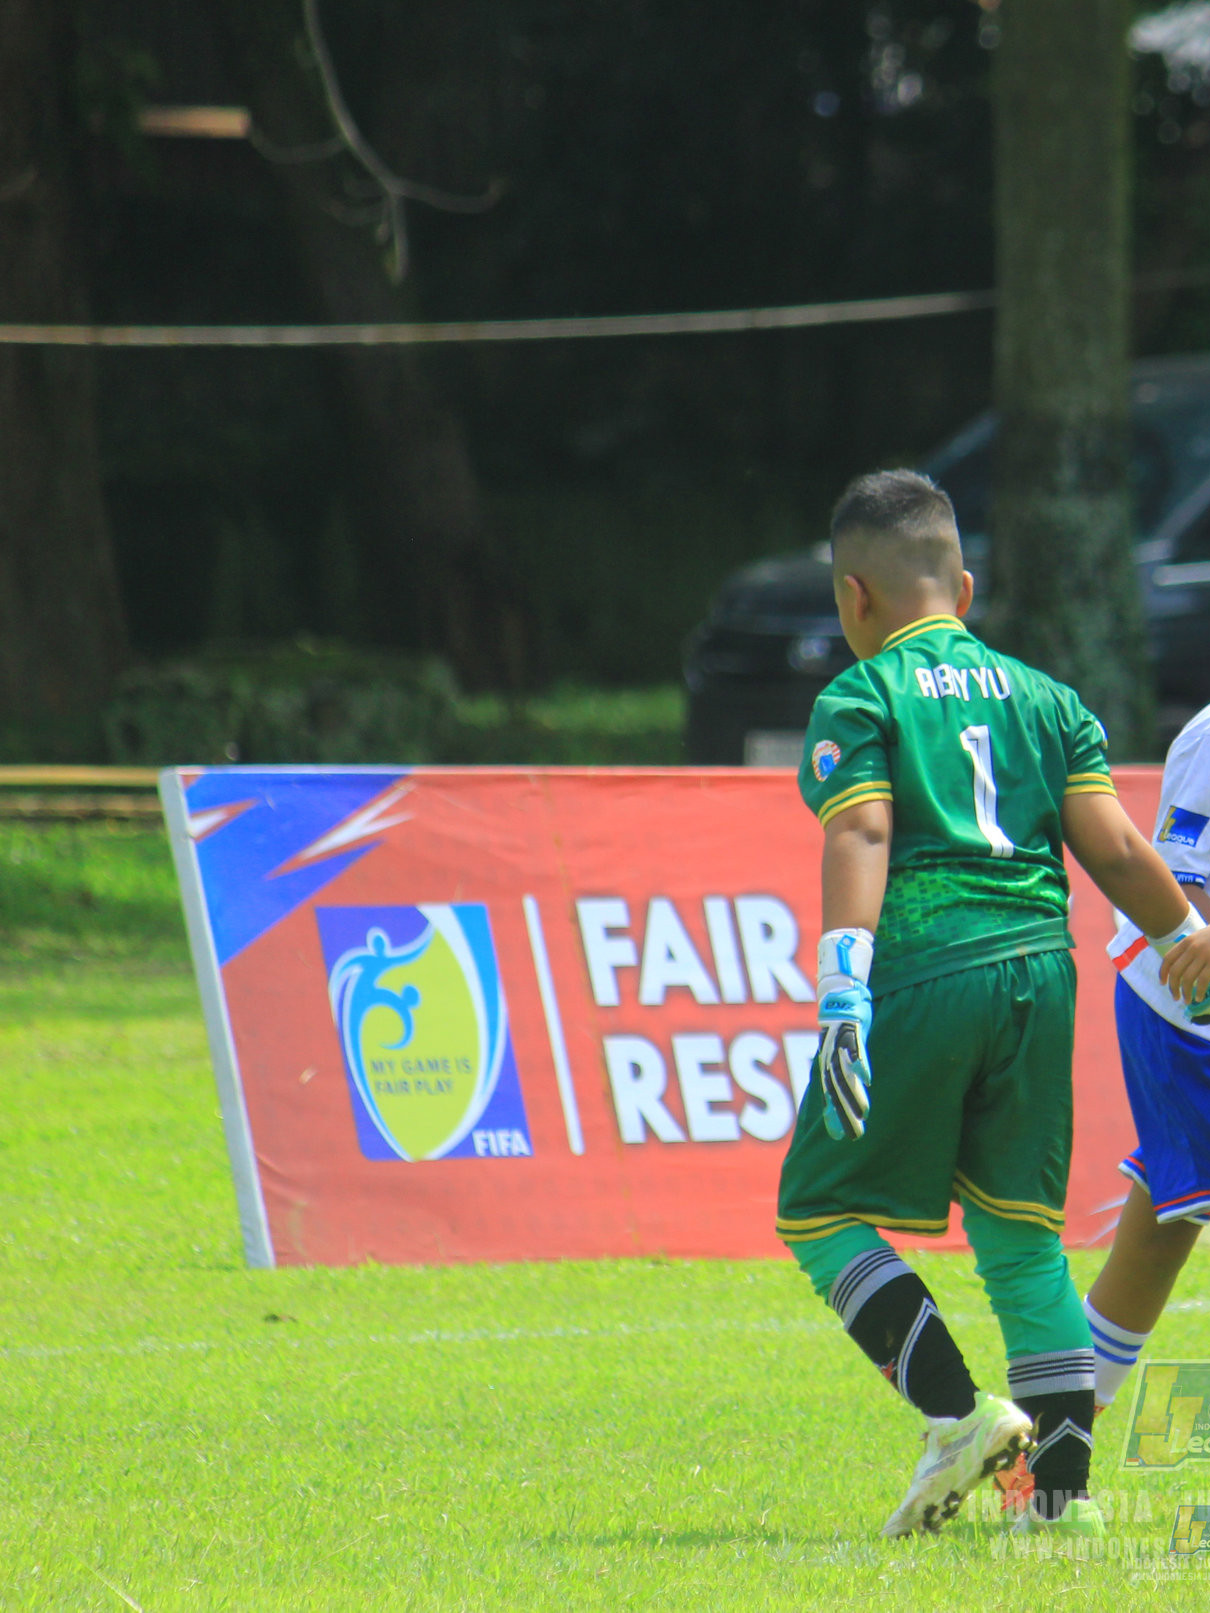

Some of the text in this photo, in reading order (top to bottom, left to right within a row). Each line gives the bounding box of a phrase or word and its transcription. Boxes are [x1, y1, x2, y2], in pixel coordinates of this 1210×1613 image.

[960, 725, 1014, 858] 1
[575, 895, 819, 1007] FAIR
[371, 1058, 472, 1075] MY GAME IS
[374, 1079, 454, 1096] FAIR PLAY
[472, 1128, 532, 1158] FIFA
